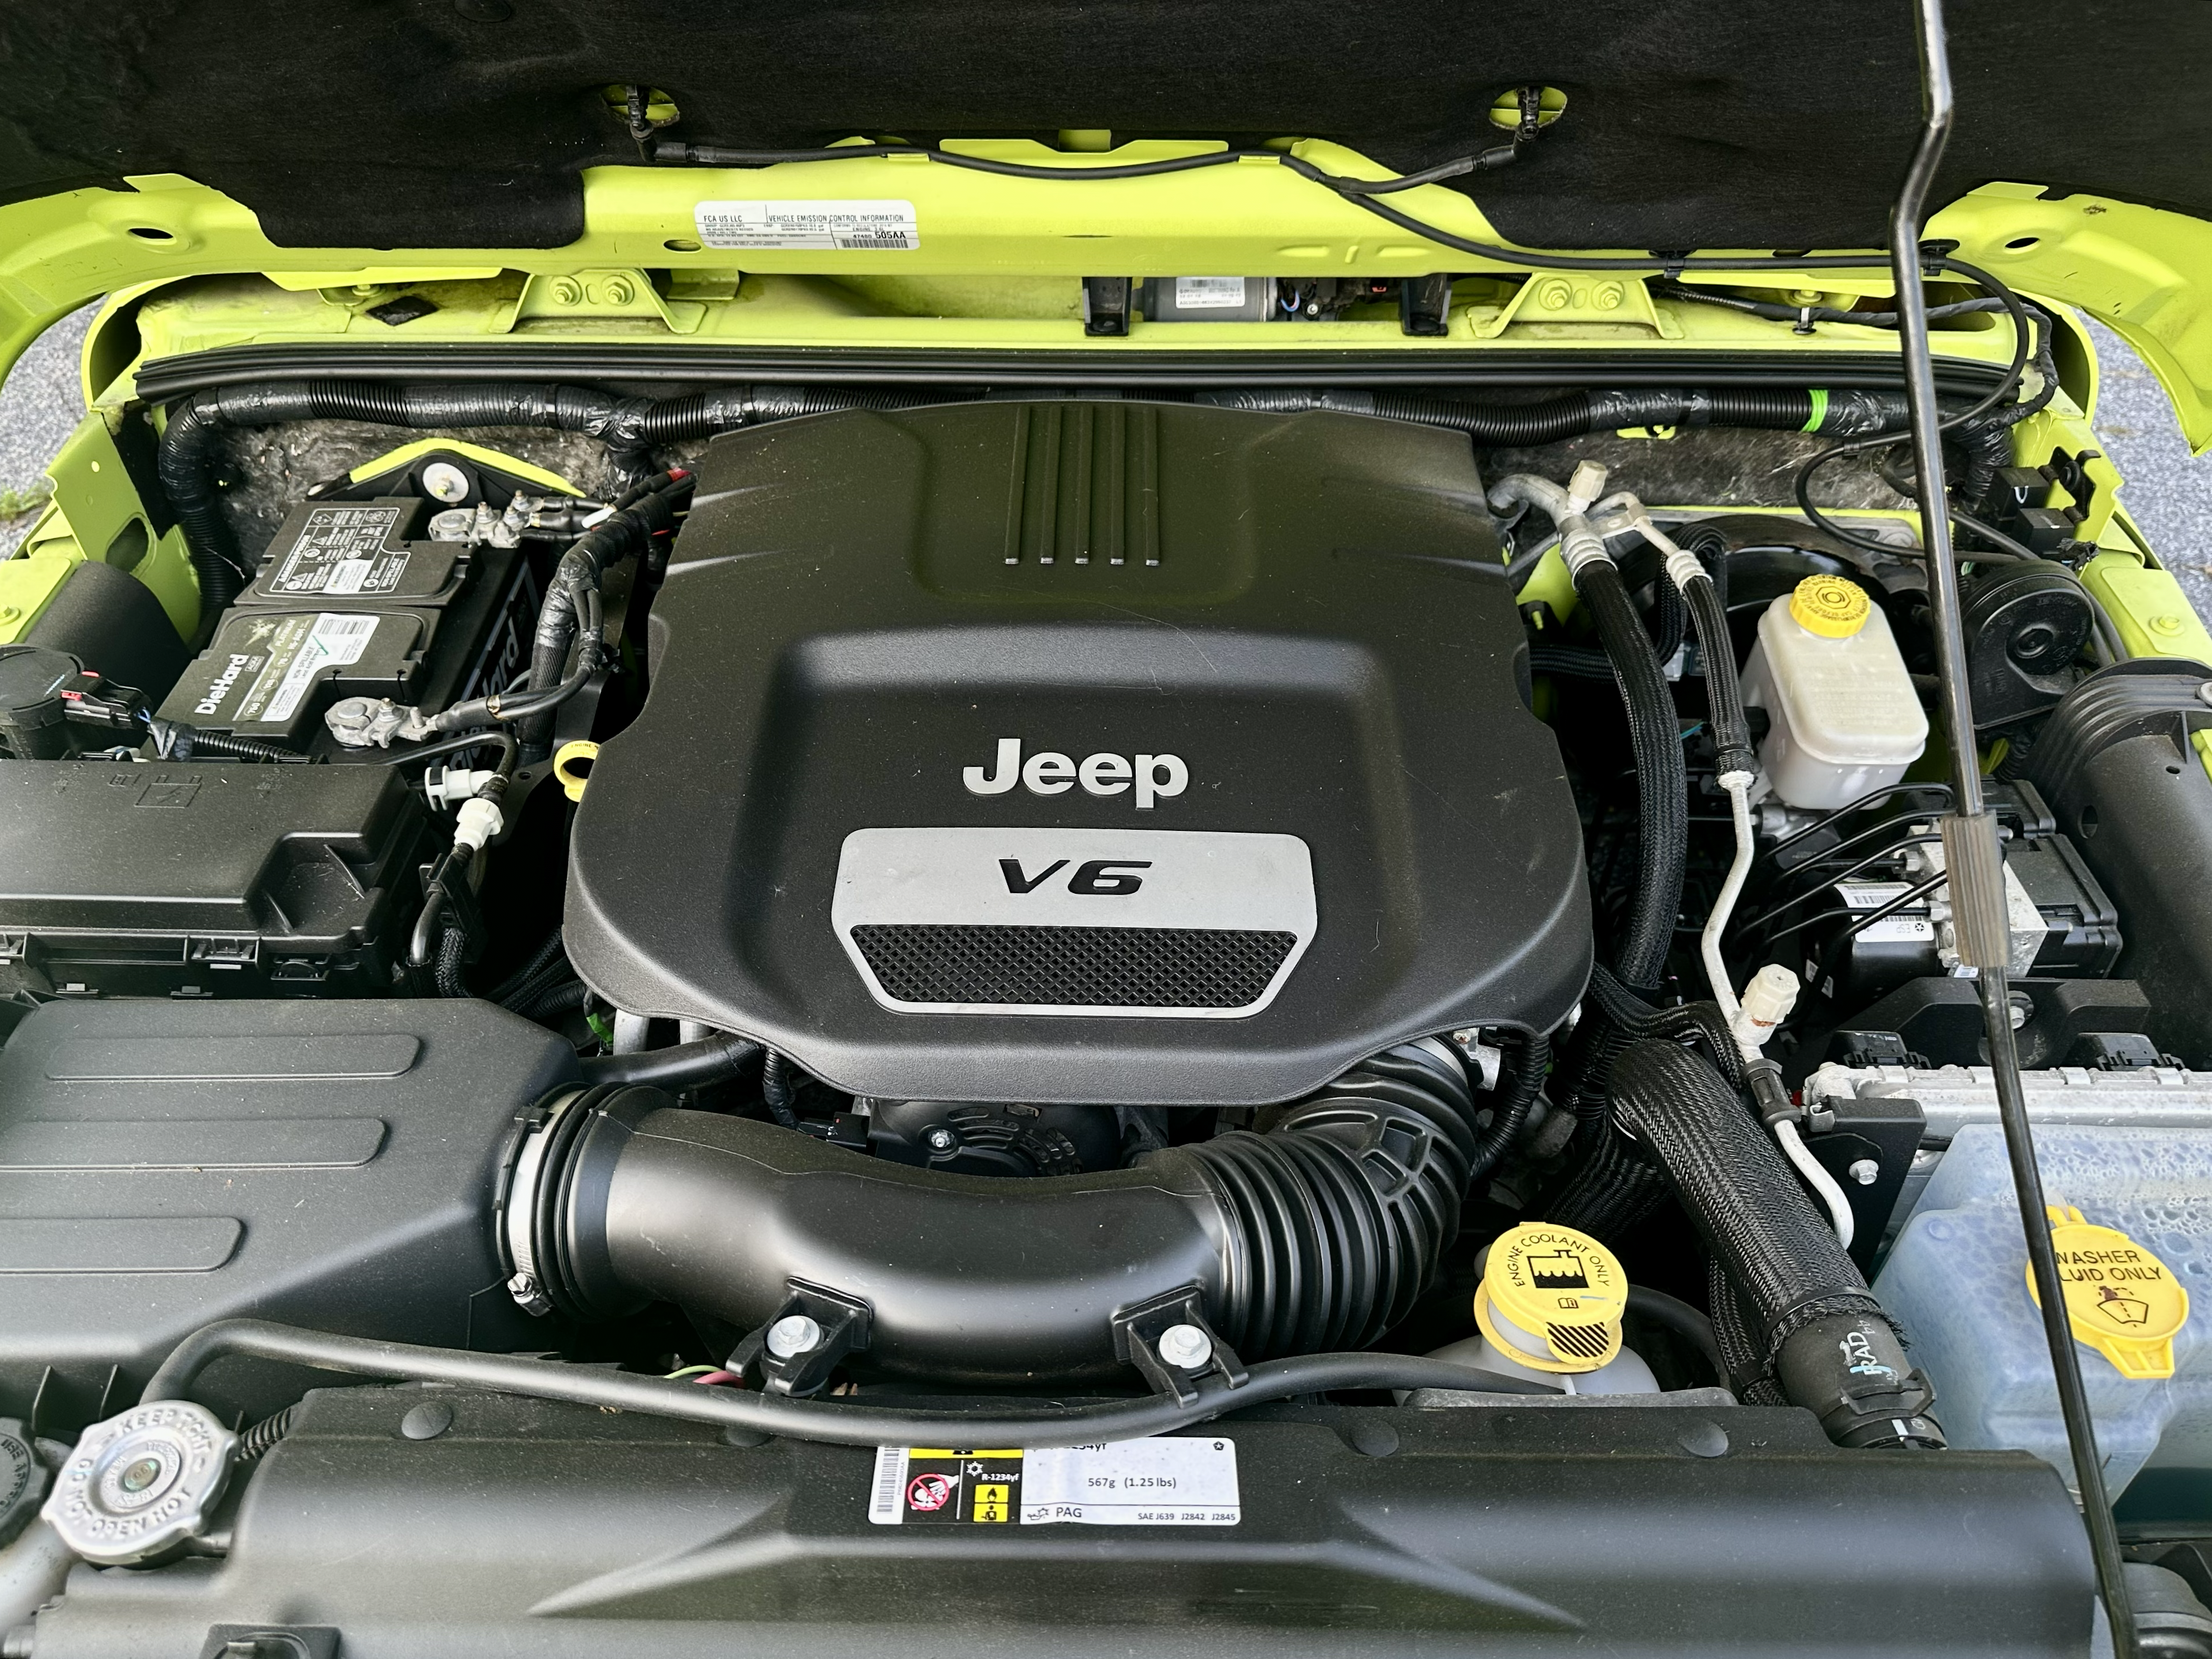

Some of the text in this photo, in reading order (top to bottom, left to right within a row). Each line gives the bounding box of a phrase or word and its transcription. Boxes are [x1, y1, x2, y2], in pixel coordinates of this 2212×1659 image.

[194, 653, 249, 715] DieHard
[247, 702, 260, 715] 760
[963, 738, 1189, 809] Jeep
[998, 858, 1153, 895] V6
[1507, 1233, 1610, 1287] ENGINE COOLANT ONLY
[2060, 1266, 2162, 1282] LUID ONLY
[1847, 1331, 1883, 1375] RAD
[115, 1408, 213, 1454] KEEP TIGHT
[981, 1473, 1019, 1482] R-1234yf
[1088, 1477, 1177, 1489] 567g (1.25 lbs)
[87, 1516, 146, 1539] OPEN
[149, 1487, 191, 1526] HOT
[1056, 1507, 1082, 1518] PAG
[1155, 1513, 1175, 1521] J639
[1181, 1513, 1205, 1521] J2842
